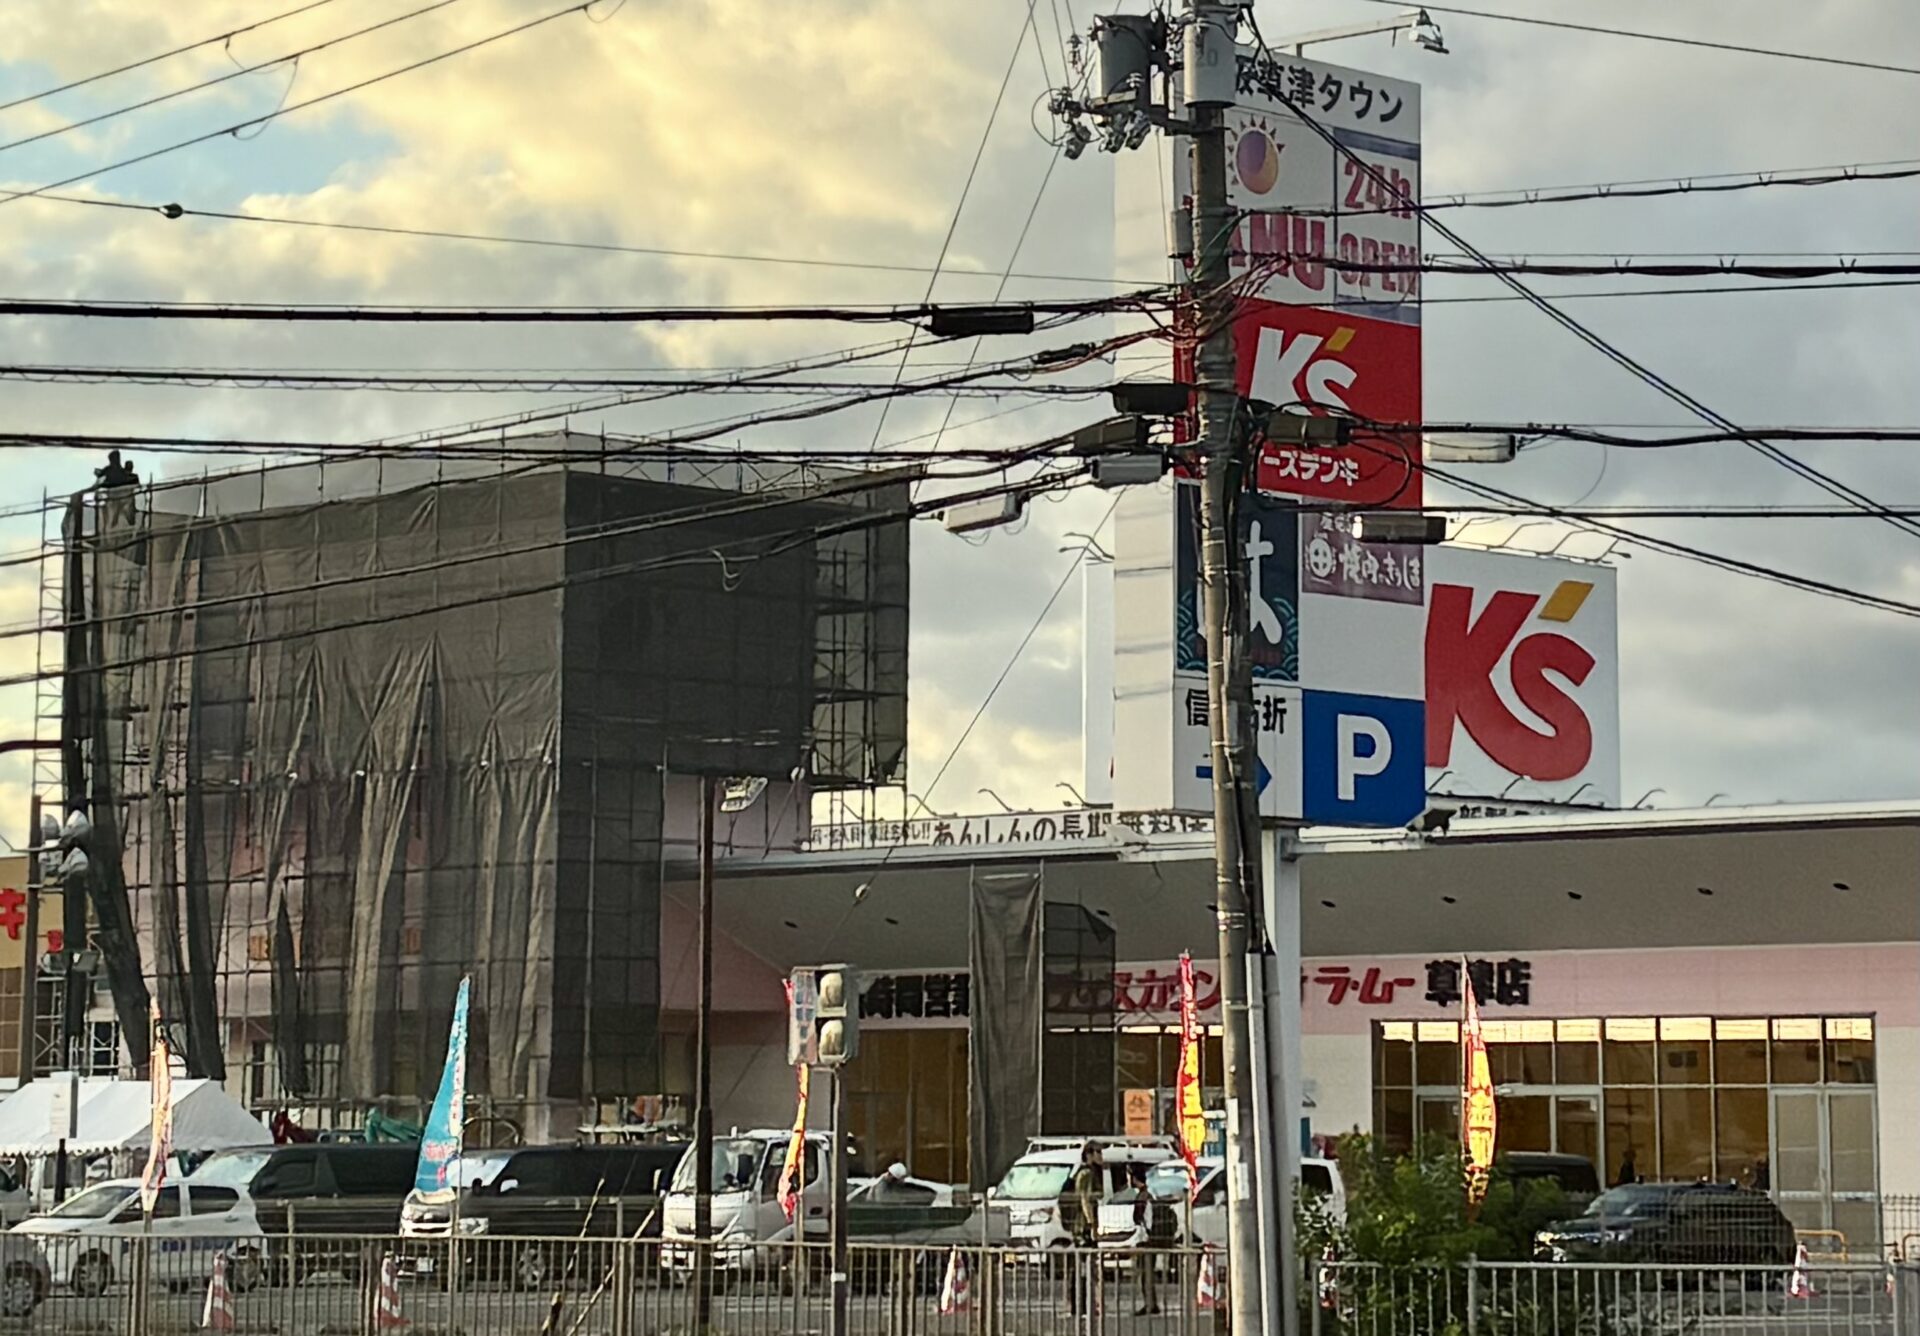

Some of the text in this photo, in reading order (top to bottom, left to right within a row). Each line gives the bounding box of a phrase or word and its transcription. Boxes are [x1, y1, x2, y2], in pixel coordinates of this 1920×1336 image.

[1344, 159, 1412, 219] 24h
[1340, 233, 1417, 296] OPEN
[1259, 449, 1360, 487] ーズデンキ
[1185, 688, 1288, 734] 信折
[1336, 713, 1393, 801] P
[859, 974, 970, 1019] 時間営業
